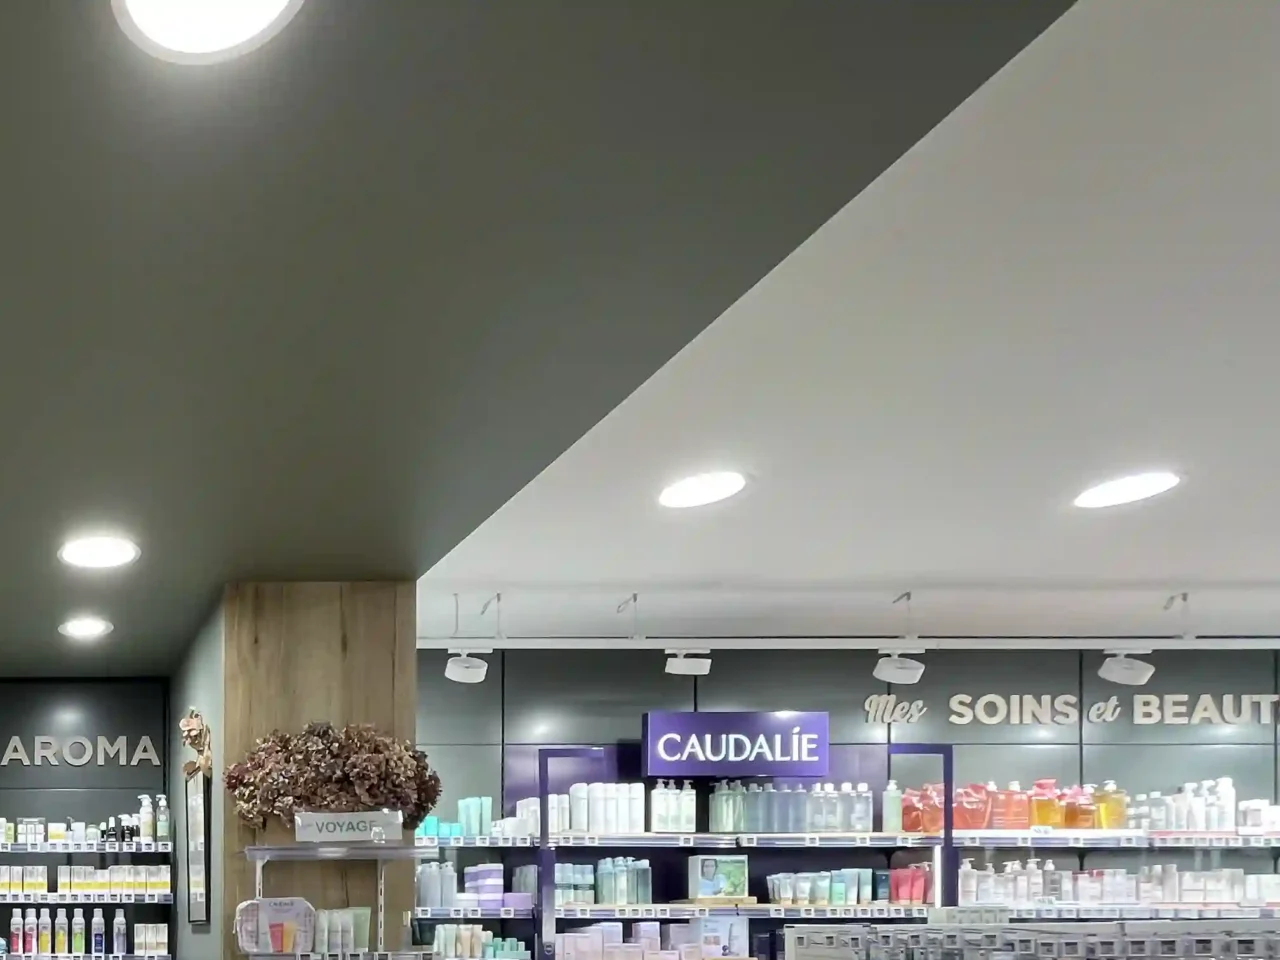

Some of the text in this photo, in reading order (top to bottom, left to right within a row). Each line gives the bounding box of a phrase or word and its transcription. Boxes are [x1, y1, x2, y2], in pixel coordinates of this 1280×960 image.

[863, 693, 1280, 726] Mes SOINS et BEAUT
[0, 735, 162, 767] AROMA
[656, 726, 820, 763] CAUDALÍE
